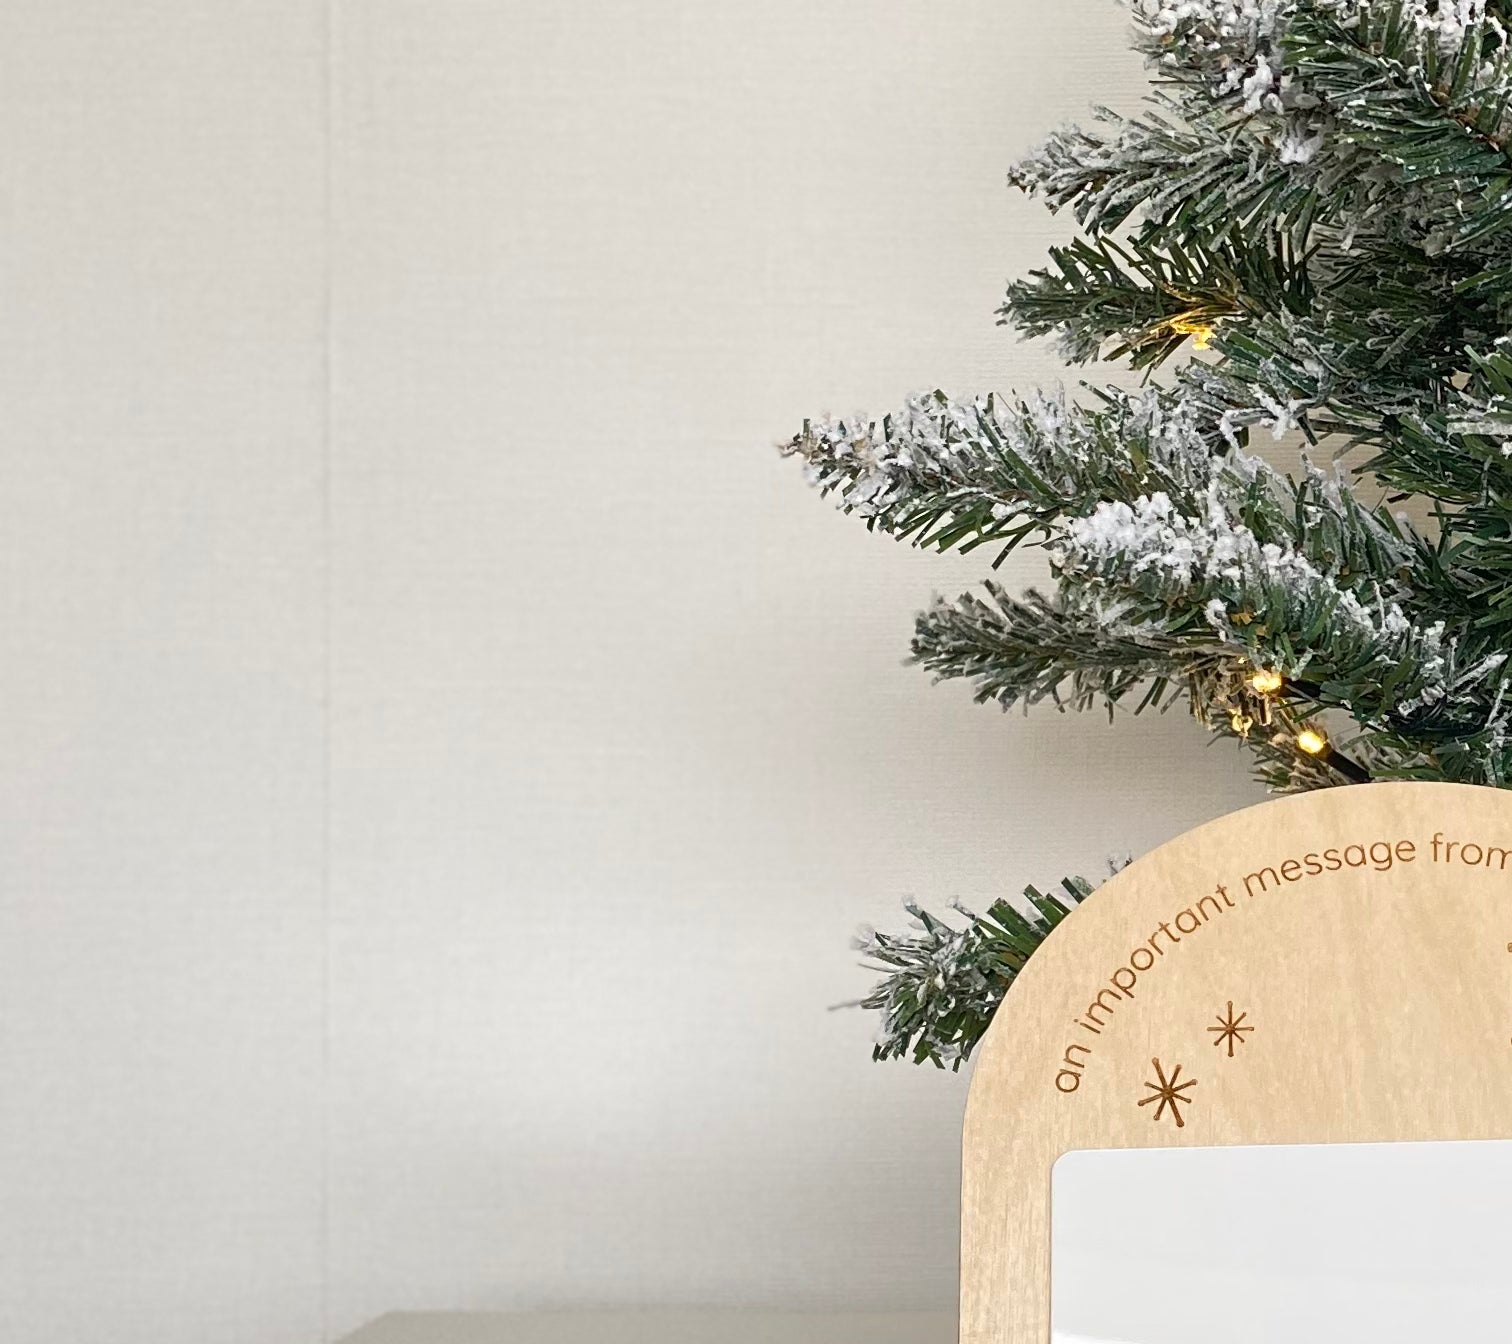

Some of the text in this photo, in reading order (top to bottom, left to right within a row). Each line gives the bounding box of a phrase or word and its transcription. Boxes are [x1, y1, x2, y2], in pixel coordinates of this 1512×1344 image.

[1242, 838, 1417, 898] message
[1073, 882, 1235, 1037] important
[1055, 1043, 1092, 1094] an
